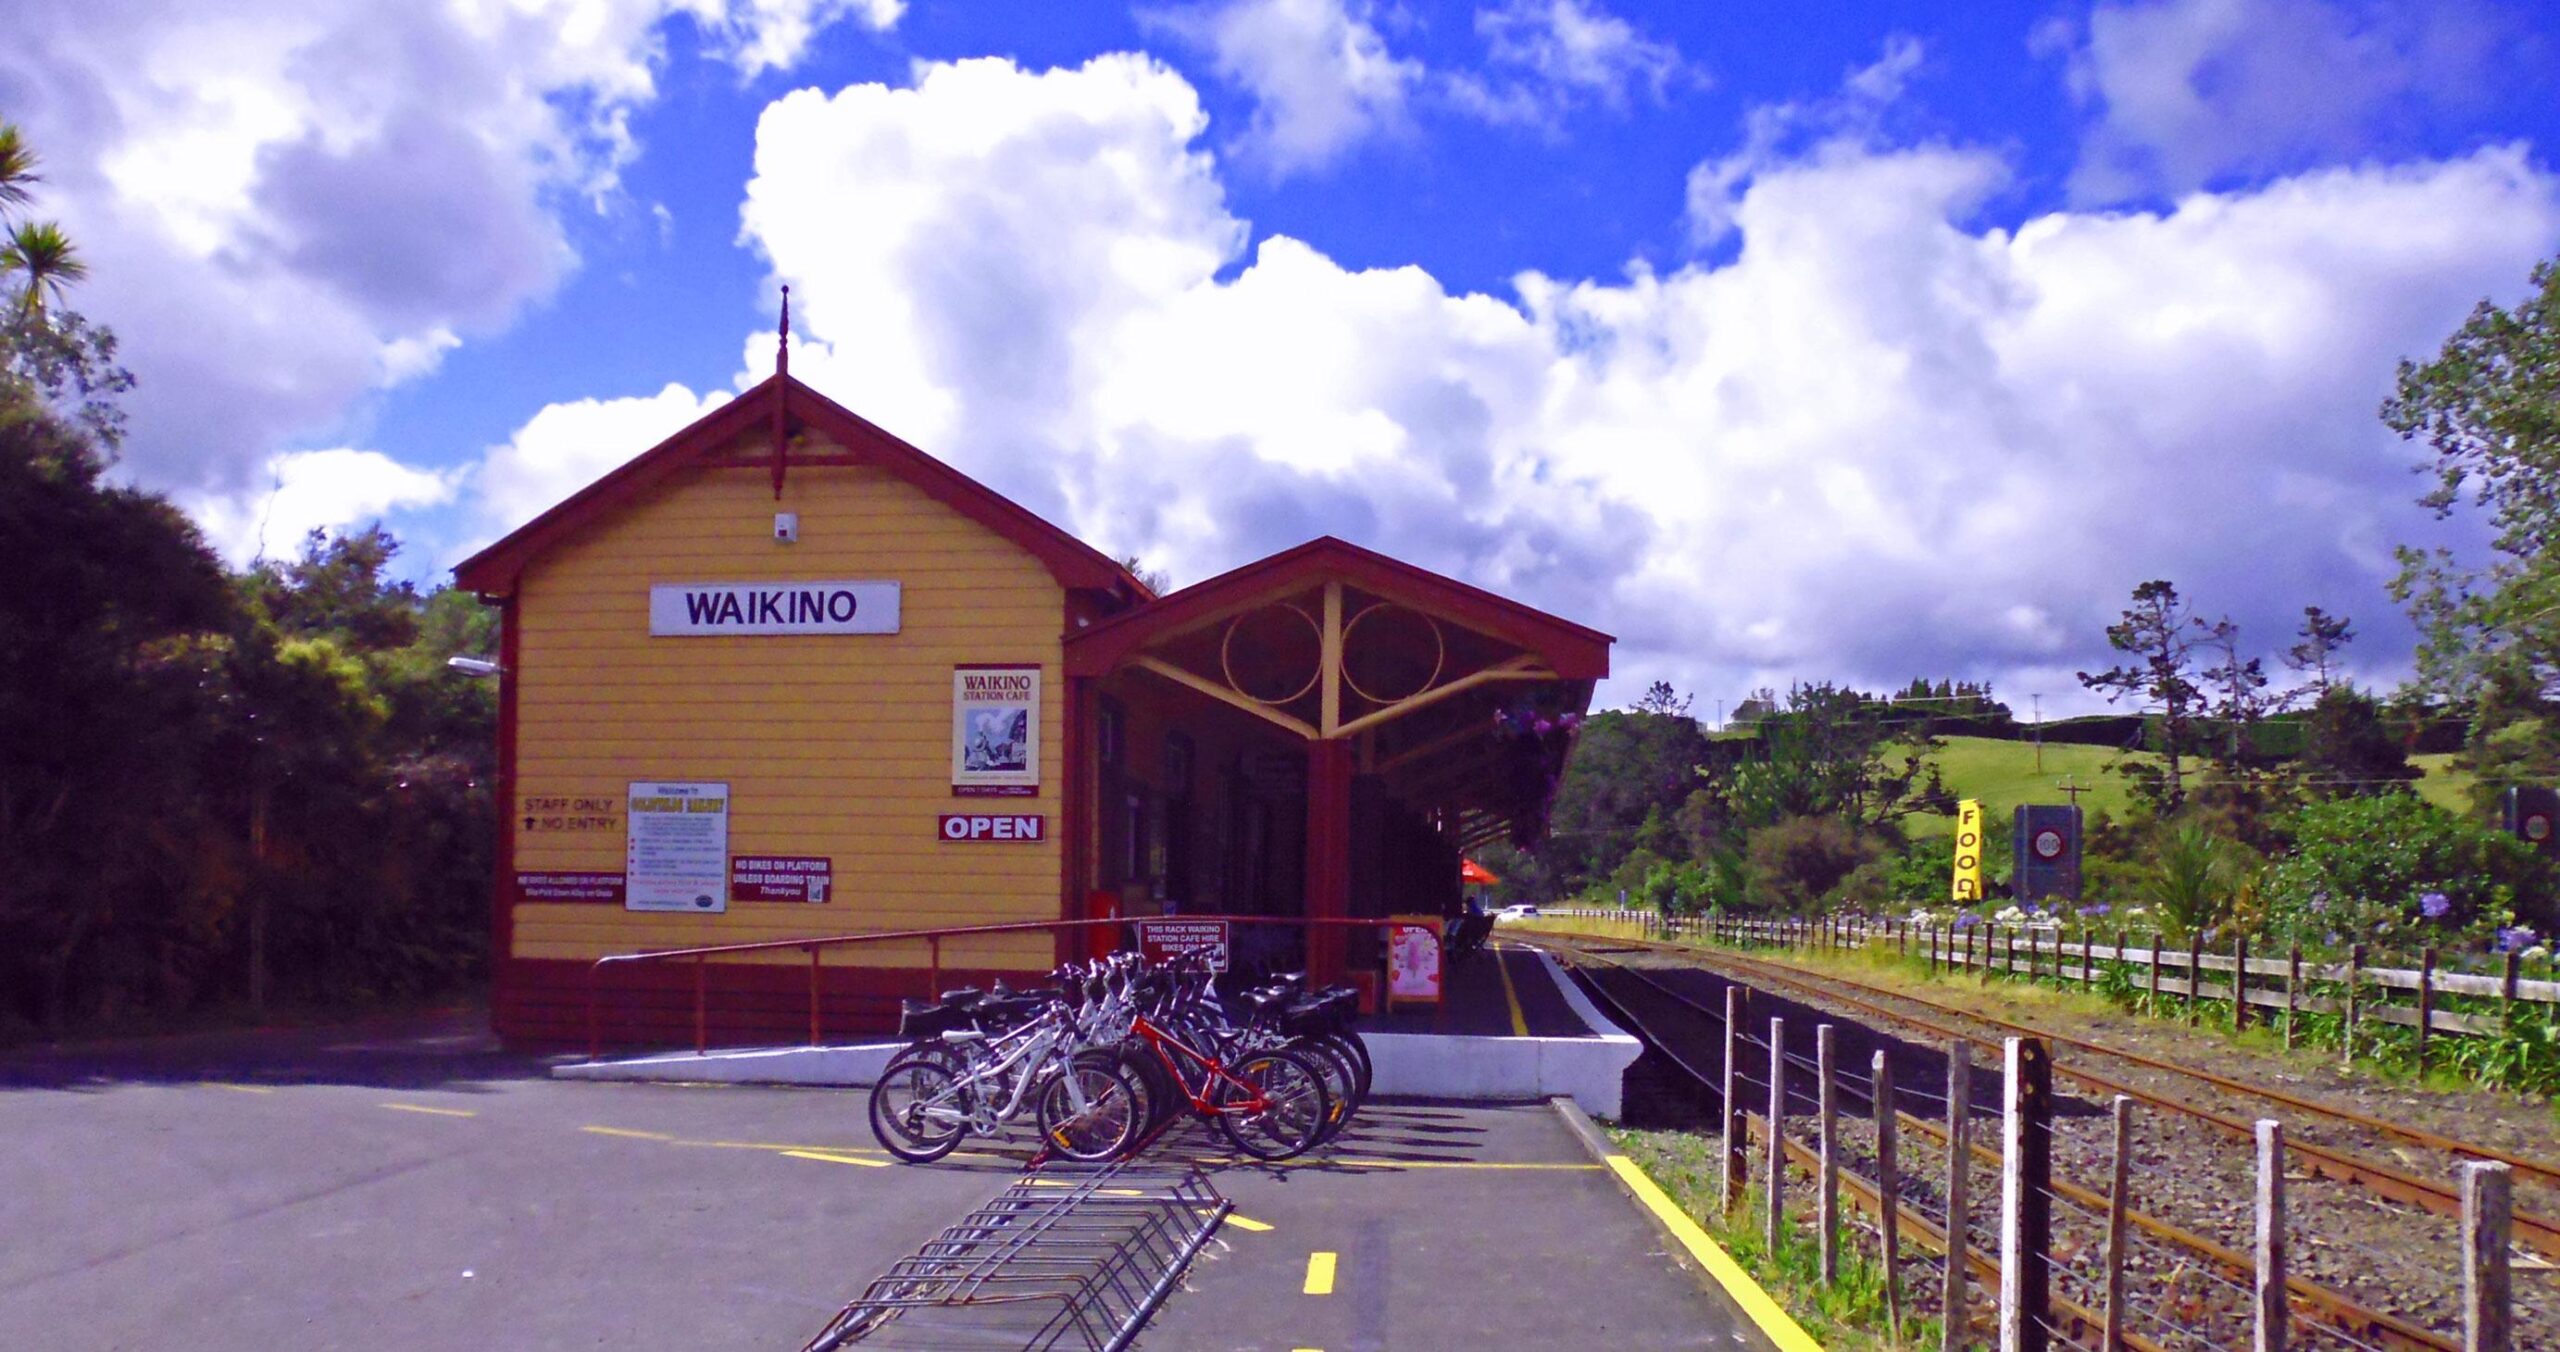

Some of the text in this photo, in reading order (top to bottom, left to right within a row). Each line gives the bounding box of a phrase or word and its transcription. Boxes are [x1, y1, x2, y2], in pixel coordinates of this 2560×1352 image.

[686, 591, 857, 625] WAIKINO
[963, 675, 1031, 691] WAIKINO
[963, 691, 1031, 701] STATION CAFE
[525, 798, 613, 812] STAFF ONLY
[542, 817, 616, 830] NO ENTRY
[945, 817, 1038, 839] OPEN
[1957, 810, 1977, 895] FOOD
[735, 860, 748, 870] NO
[786, 861, 827, 871] PLATFORM
[733, 874, 763, 884] UNLESS
[764, 874, 804, 885] BOARDING
[1147, 925, 1221, 934] THIS RACK WAIKINO
[1147, 934, 1178, 943] STATION
[1179, 935, 1201, 943] CAFE
[1161, 943, 1184, 952] BIKES
